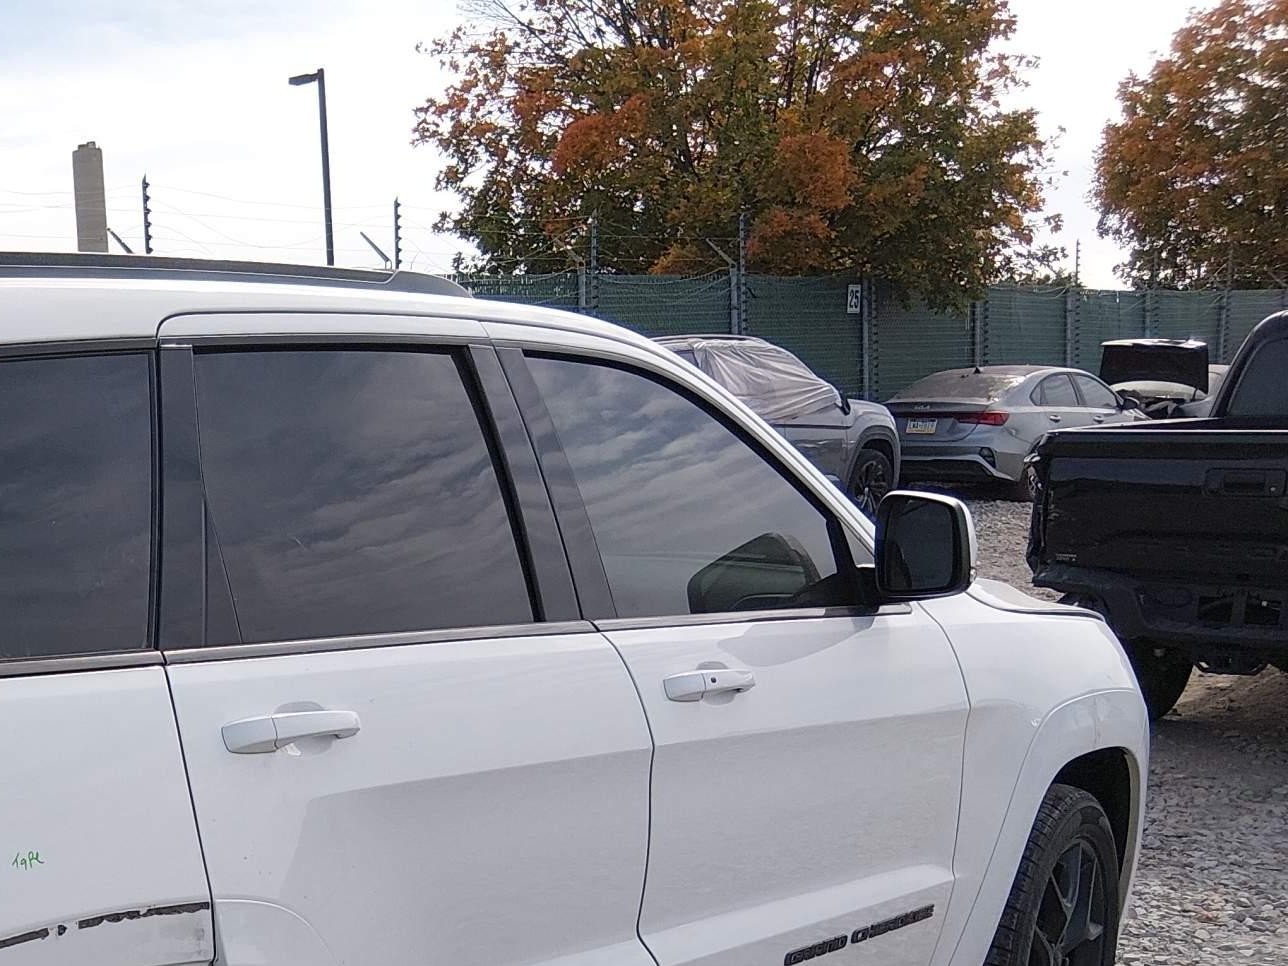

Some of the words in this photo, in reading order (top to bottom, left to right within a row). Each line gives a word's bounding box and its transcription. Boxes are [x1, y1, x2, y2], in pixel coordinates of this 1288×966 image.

[849, 289, 859, 308] 25
[784, 934, 848, 966] GRAND
[850, 903, 935, 944] CHEROKEE
